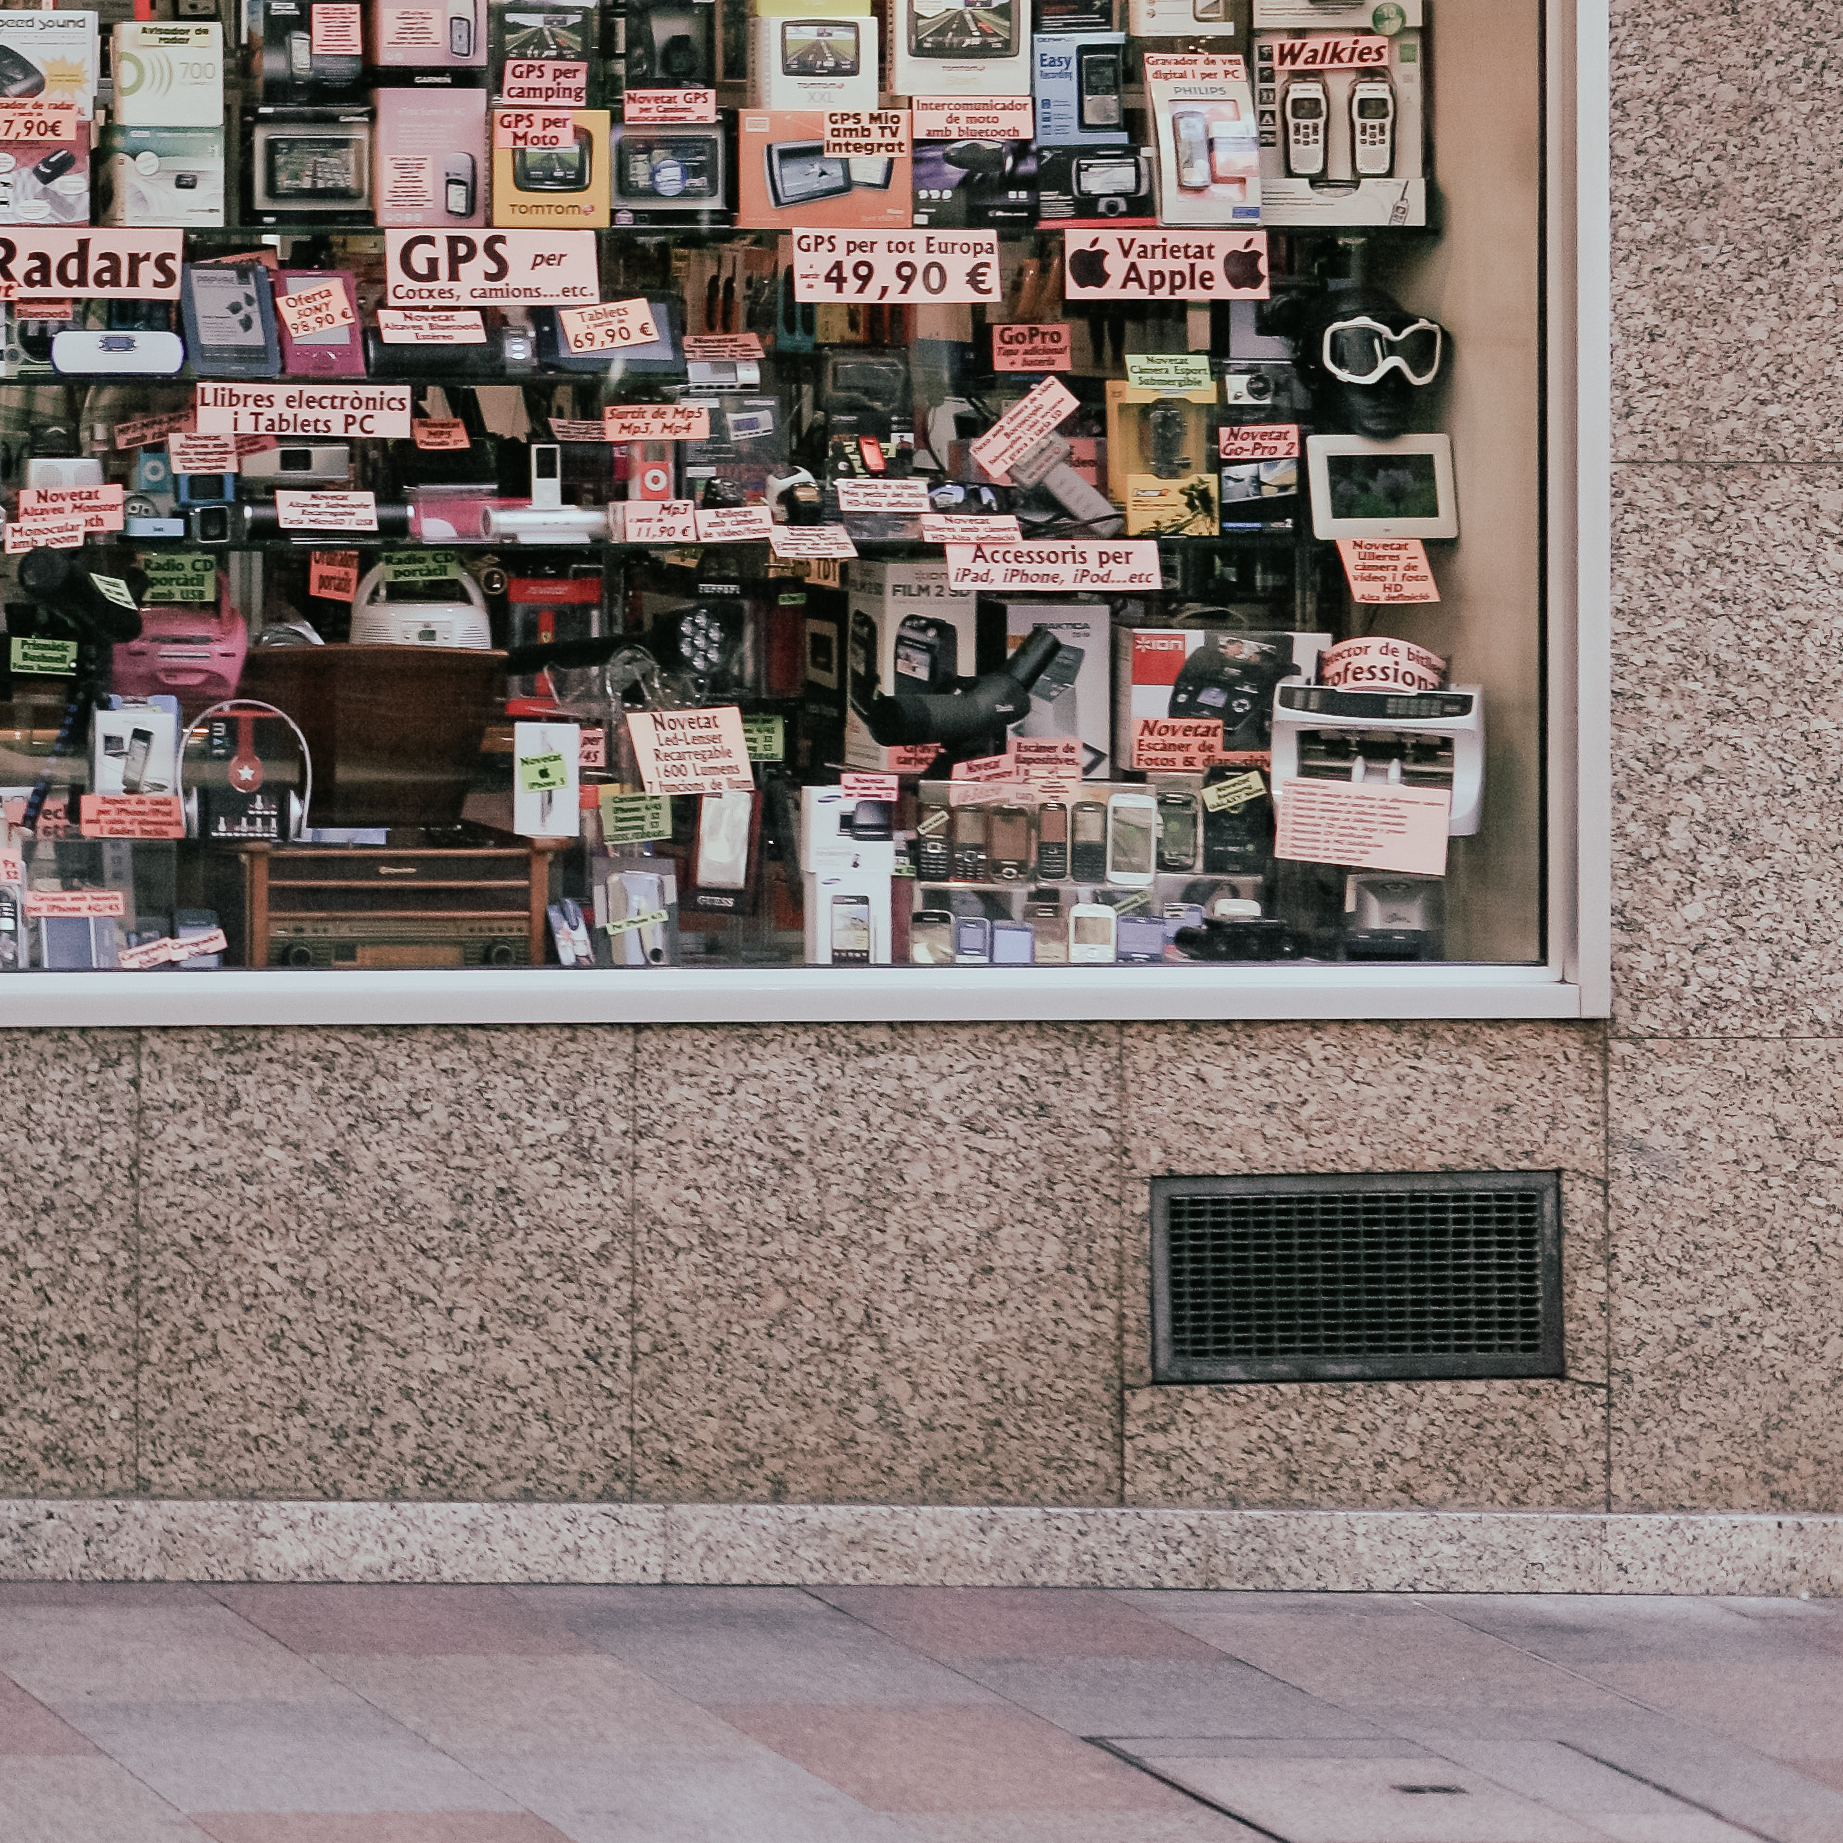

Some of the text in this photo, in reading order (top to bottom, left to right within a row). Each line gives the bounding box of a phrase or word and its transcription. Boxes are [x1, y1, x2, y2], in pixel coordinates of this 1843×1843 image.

[1039, 53, 1071, 70] Easy
[1276, 41, 1386, 68] Walkies
[512, 65, 579, 83] GPS per
[507, 83, 586, 103] camping
[627, 91, 708, 105] Novetat GPS
[500, 114, 569, 134] GPS per
[829, 113, 900, 126] GPS Mio
[946, 113, 998, 125] de moto
[512, 131, 559, 147] Moto
[830, 126, 900, 139] amb TV
[926, 126, 1019, 138] amb bluetooth
[798, 236, 995, 258] GPS per tot Europa
[1117, 237, 1214, 260] Varietat
[400, 235, 567, 283] GPS per
[825, 261, 993, 300] 49,90 €
[1120, 262, 1214, 295] Apple
[393, 284, 460, 301] Cotxes,
[577, 307, 628, 323] Tablets
[291, 313, 336, 336] 98,90
[574, 323, 653, 349] 69,90 €
[999, 327, 1062, 345] GoPro
[1138, 375, 1202, 387] Submergible
[200, 387, 406, 412] Llibres electrònics
[233, 412, 374, 433] i Tablets PC
[619, 421, 692, 436] Mp3, Mp4
[1227, 427, 1290, 442] Novetat
[1223, 442, 1295, 457] Go-Pro 2
[36, 489, 100, 503] Novetat
[637, 525, 676, 539] 11,90
[972, 545, 1133, 567] Accessoris per
[1358, 552, 1399, 562] Ulleres
[954, 567, 994, 585] iPad,
[1003, 568, 1064, 585] iPhone,
[653, 714, 719, 732] Novetat
[1140, 720, 1220, 737] Novetat
[658, 732, 722, 746] Led-Lenser
